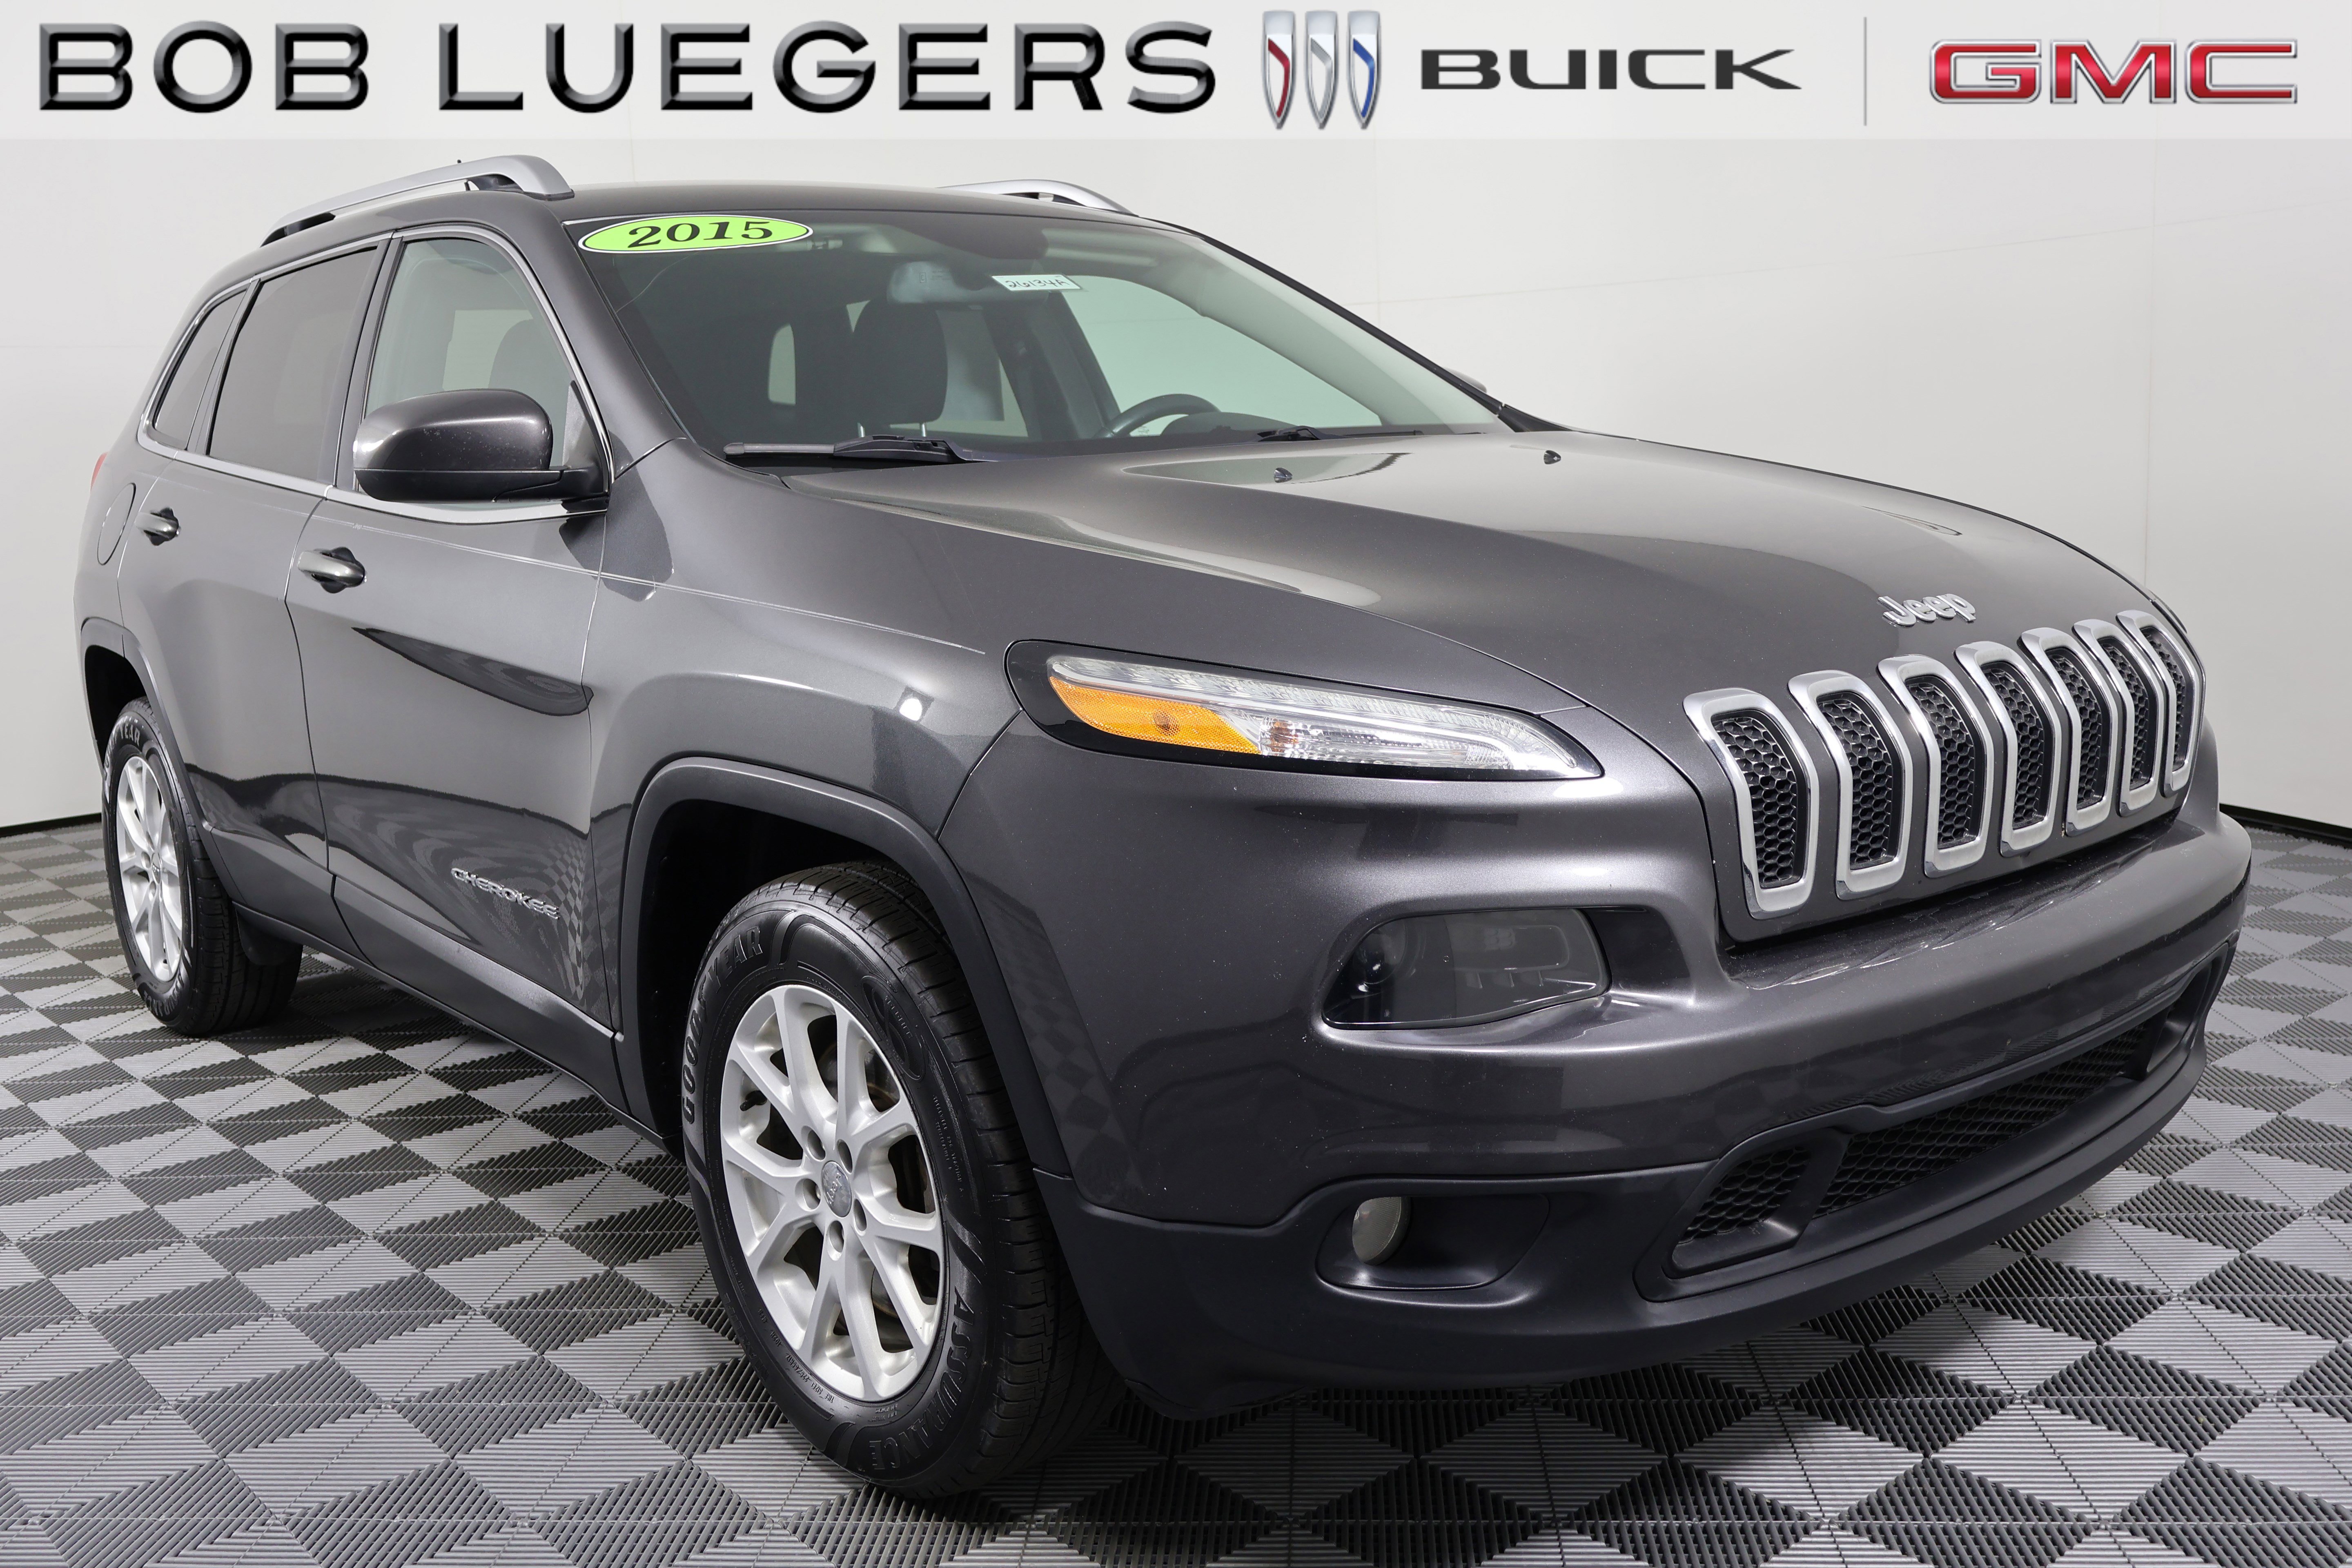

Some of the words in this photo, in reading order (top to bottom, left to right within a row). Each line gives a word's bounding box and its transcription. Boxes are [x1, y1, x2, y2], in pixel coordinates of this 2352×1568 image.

[628, 222, 774, 248] 2015
[1005, 278, 1071, 288] 26134A
[1877, 593, 1976, 626] Jeep
[451, 867, 560, 920] CHEROKEE
[682, 926, 764, 1125] GOODYEAR
[869, 1285, 975, 1470] ASSURANCE
